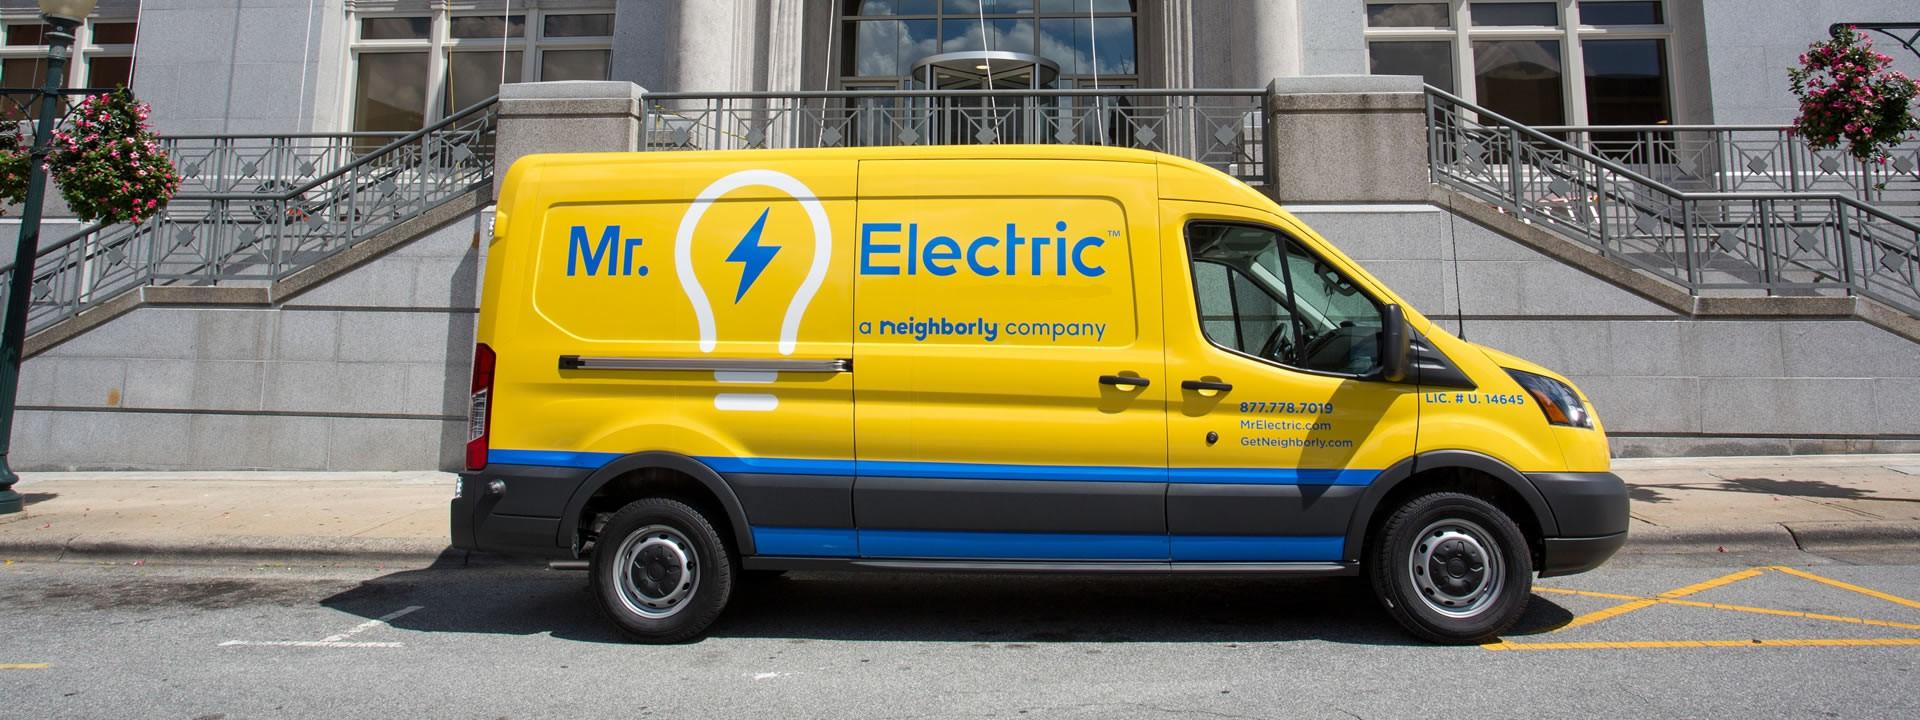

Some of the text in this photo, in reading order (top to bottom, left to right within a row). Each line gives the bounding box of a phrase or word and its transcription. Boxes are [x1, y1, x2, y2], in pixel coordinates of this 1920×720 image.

[567, 225, 649, 277] Mr.
[860, 220, 1106, 277] Electric
[859, 316, 1106, 342] a neighborly company
[1425, 393, 1524, 405] LIC. # U. 14645
[1240, 402, 1334, 414] 877.778.7019
[1240, 420, 1332, 431] MrElectric.com
[1241, 436, 1353, 448] GetNeighborly.com
